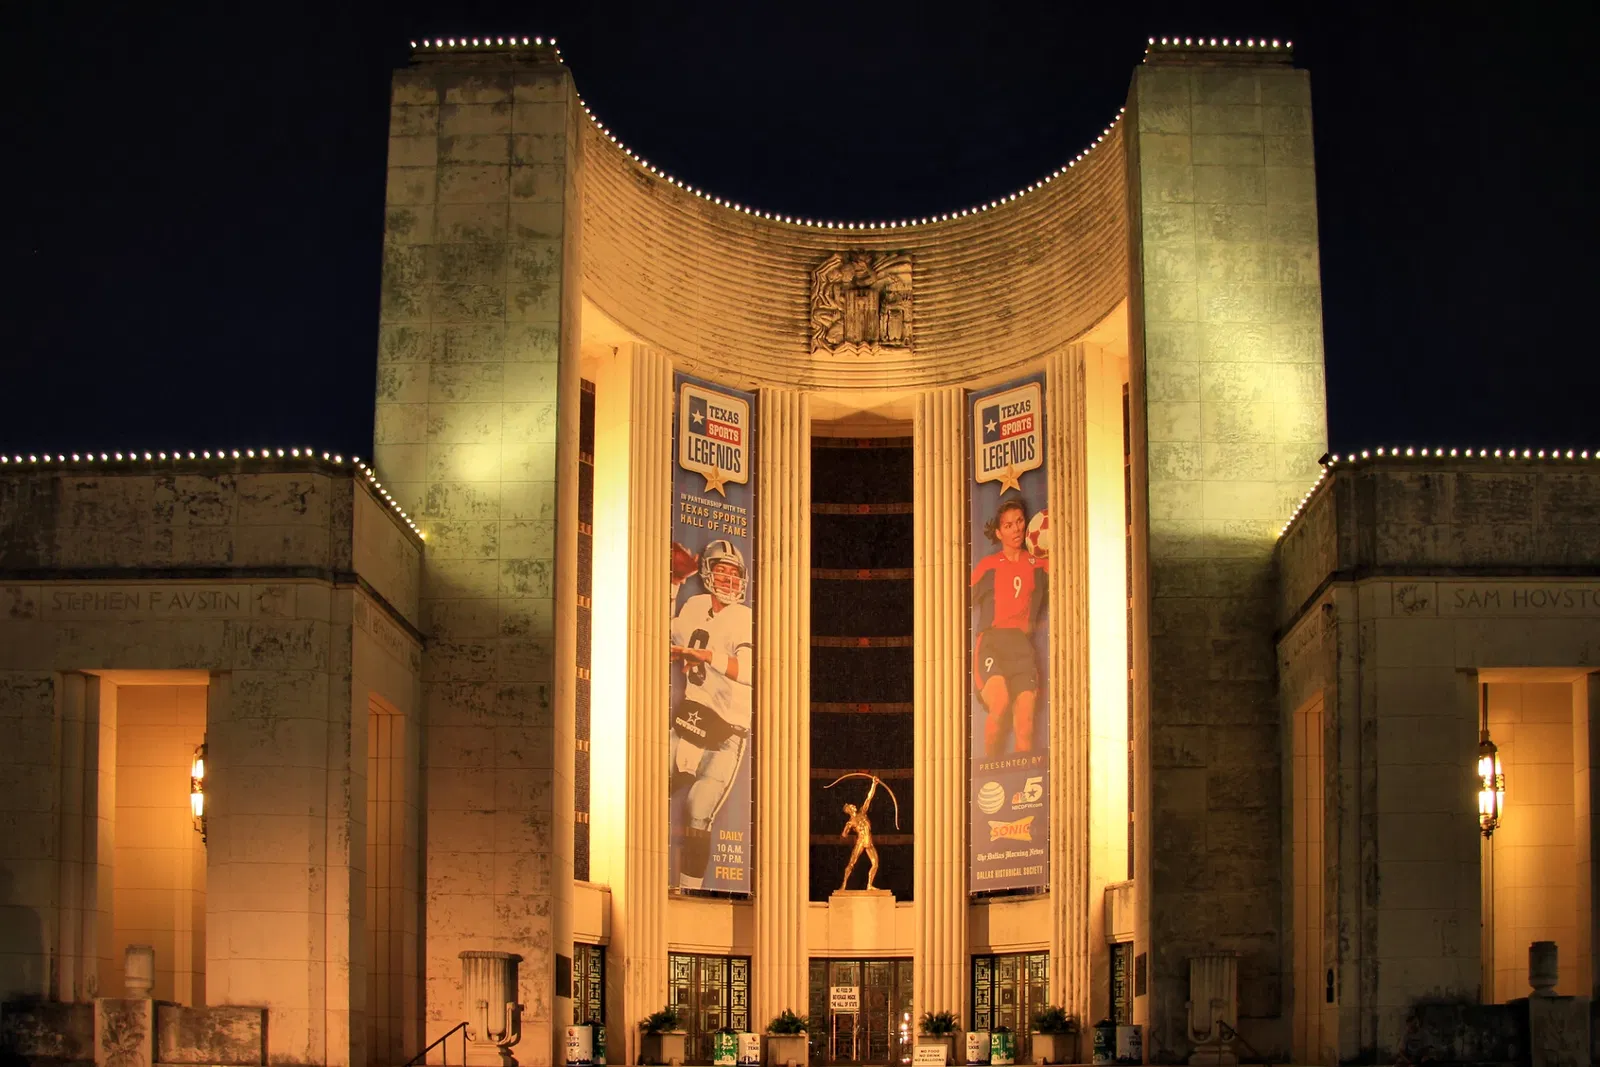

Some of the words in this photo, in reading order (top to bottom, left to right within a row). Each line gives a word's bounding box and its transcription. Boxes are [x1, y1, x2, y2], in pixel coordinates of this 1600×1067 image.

[709, 405, 739, 424] TEXAS
[1001, 400, 1031, 419] TEXAS
[708, 423, 739, 442] SPORTS
[1002, 417, 1032, 436] SPORTS
[688, 436, 741, 473] LEGENDS
[983, 435, 1035, 473] LEGENDS
[681, 493, 688, 501] IN
[687, 494, 722, 509] PARTNERSHIP
[723, 503, 736, 513] WITH
[736, 506, 747, 515] THE
[681, 502, 709, 517] TEXAS
[713, 510, 747, 526] SPORTS
[681, 513, 704, 528] HALL
[708, 520, 719, 531] OF
[723, 523, 747, 538] FAME
[1013, 575, 1022, 599] 9
[52, 591, 140, 611] STEPHEN
[149, 591, 163, 611] F
[1454, 588, 1501, 608] SAM
[985, 657, 994, 673] 9
[980, 758, 1027, 771] PRESENTED
[1031, 756, 1042, 764] BY
[1023, 776, 1043, 803] 5
[720, 830, 744, 842] DAILY
[993, 824, 1030, 837] SONIC
[717, 844, 726, 853] 10
[727, 845, 744, 854] A.M.
[976, 853, 987, 862] The
[987, 852, 1004, 861] Dallas
[1005, 850, 1028, 860] Morning
[1029, 848, 1044, 857] News
[712, 854, 720, 862] TO
[722, 854, 727, 862] 7
[728, 855, 744, 864] P.M.
[715, 866, 744, 881] FREE
[976, 870, 994, 880] DALLAS
[995, 867, 1022, 878] HISTORICAL
[1023, 865, 1043, 876] SOCIETY
